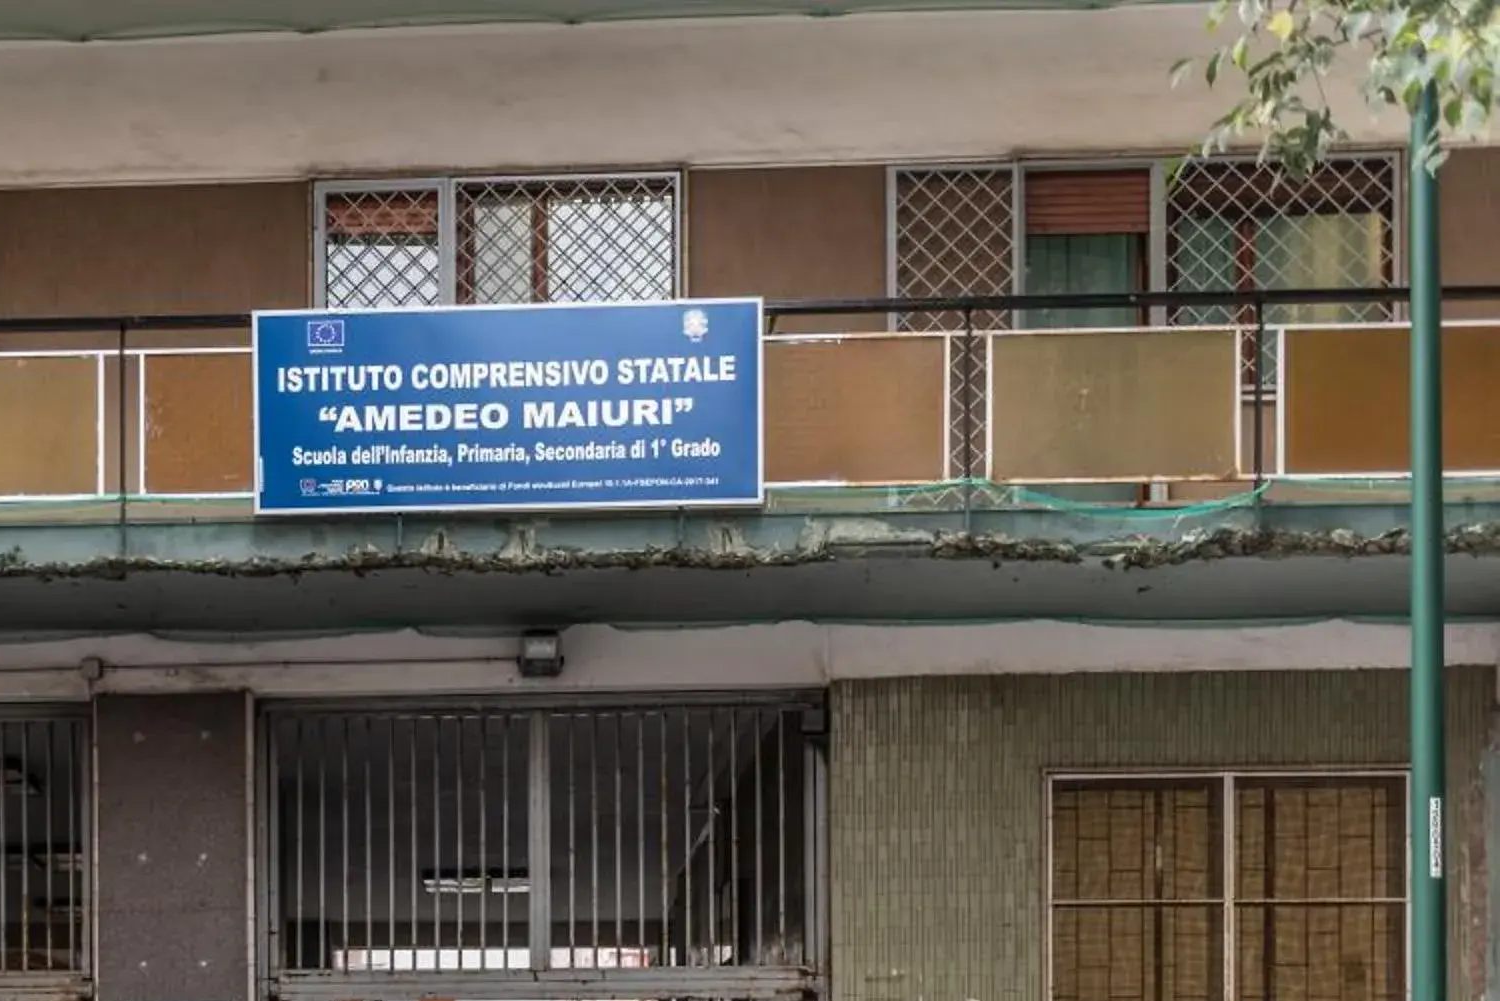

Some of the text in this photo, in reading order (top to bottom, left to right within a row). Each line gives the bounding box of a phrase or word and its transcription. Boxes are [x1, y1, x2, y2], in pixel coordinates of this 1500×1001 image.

[277, 355, 736, 392] ISTITUTO COMPRENSIVO STATALE
[319, 397, 693, 432] “AMEDEO MAIURI”
[292, 436, 721, 467] Scuola dell'Infanzia, Primaria, Secondaria di 1° Grado
